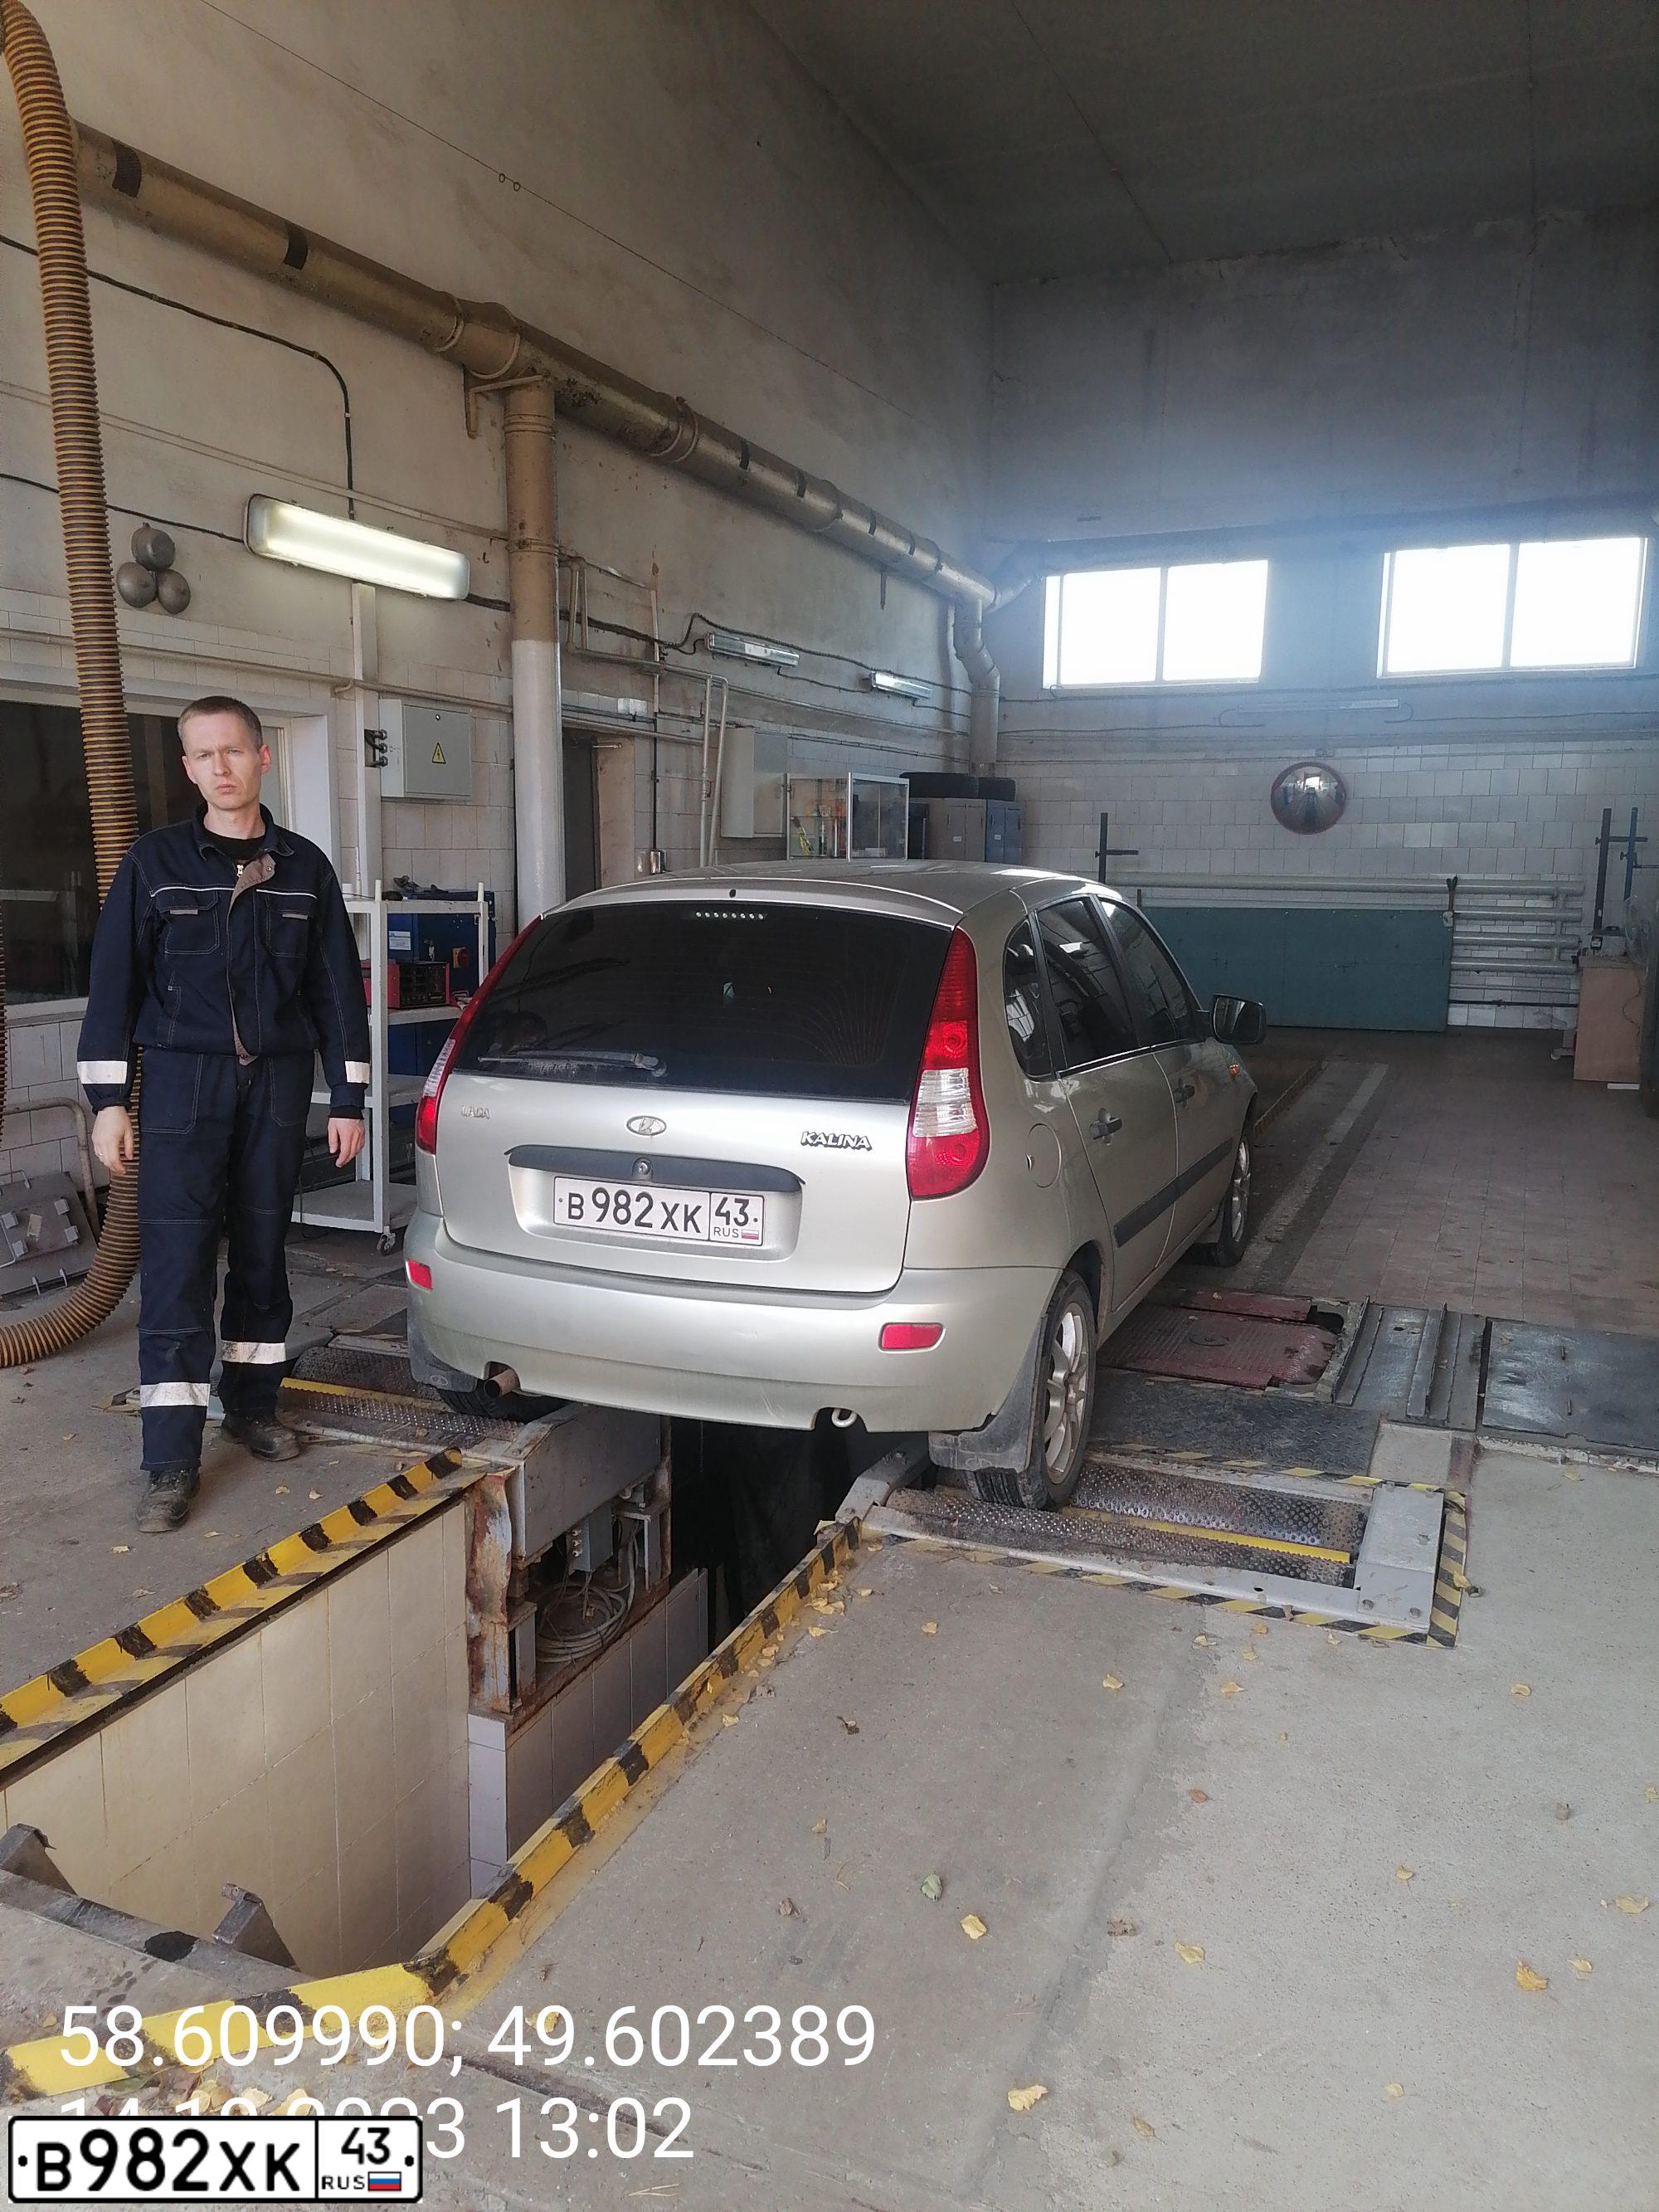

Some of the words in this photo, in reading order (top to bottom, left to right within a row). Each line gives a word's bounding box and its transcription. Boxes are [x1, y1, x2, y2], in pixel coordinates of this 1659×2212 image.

[800, 1131, 873, 1152] KALINA
[714, 1196, 750, 1227] 43
[713, 1226, 739, 1239] RUS
